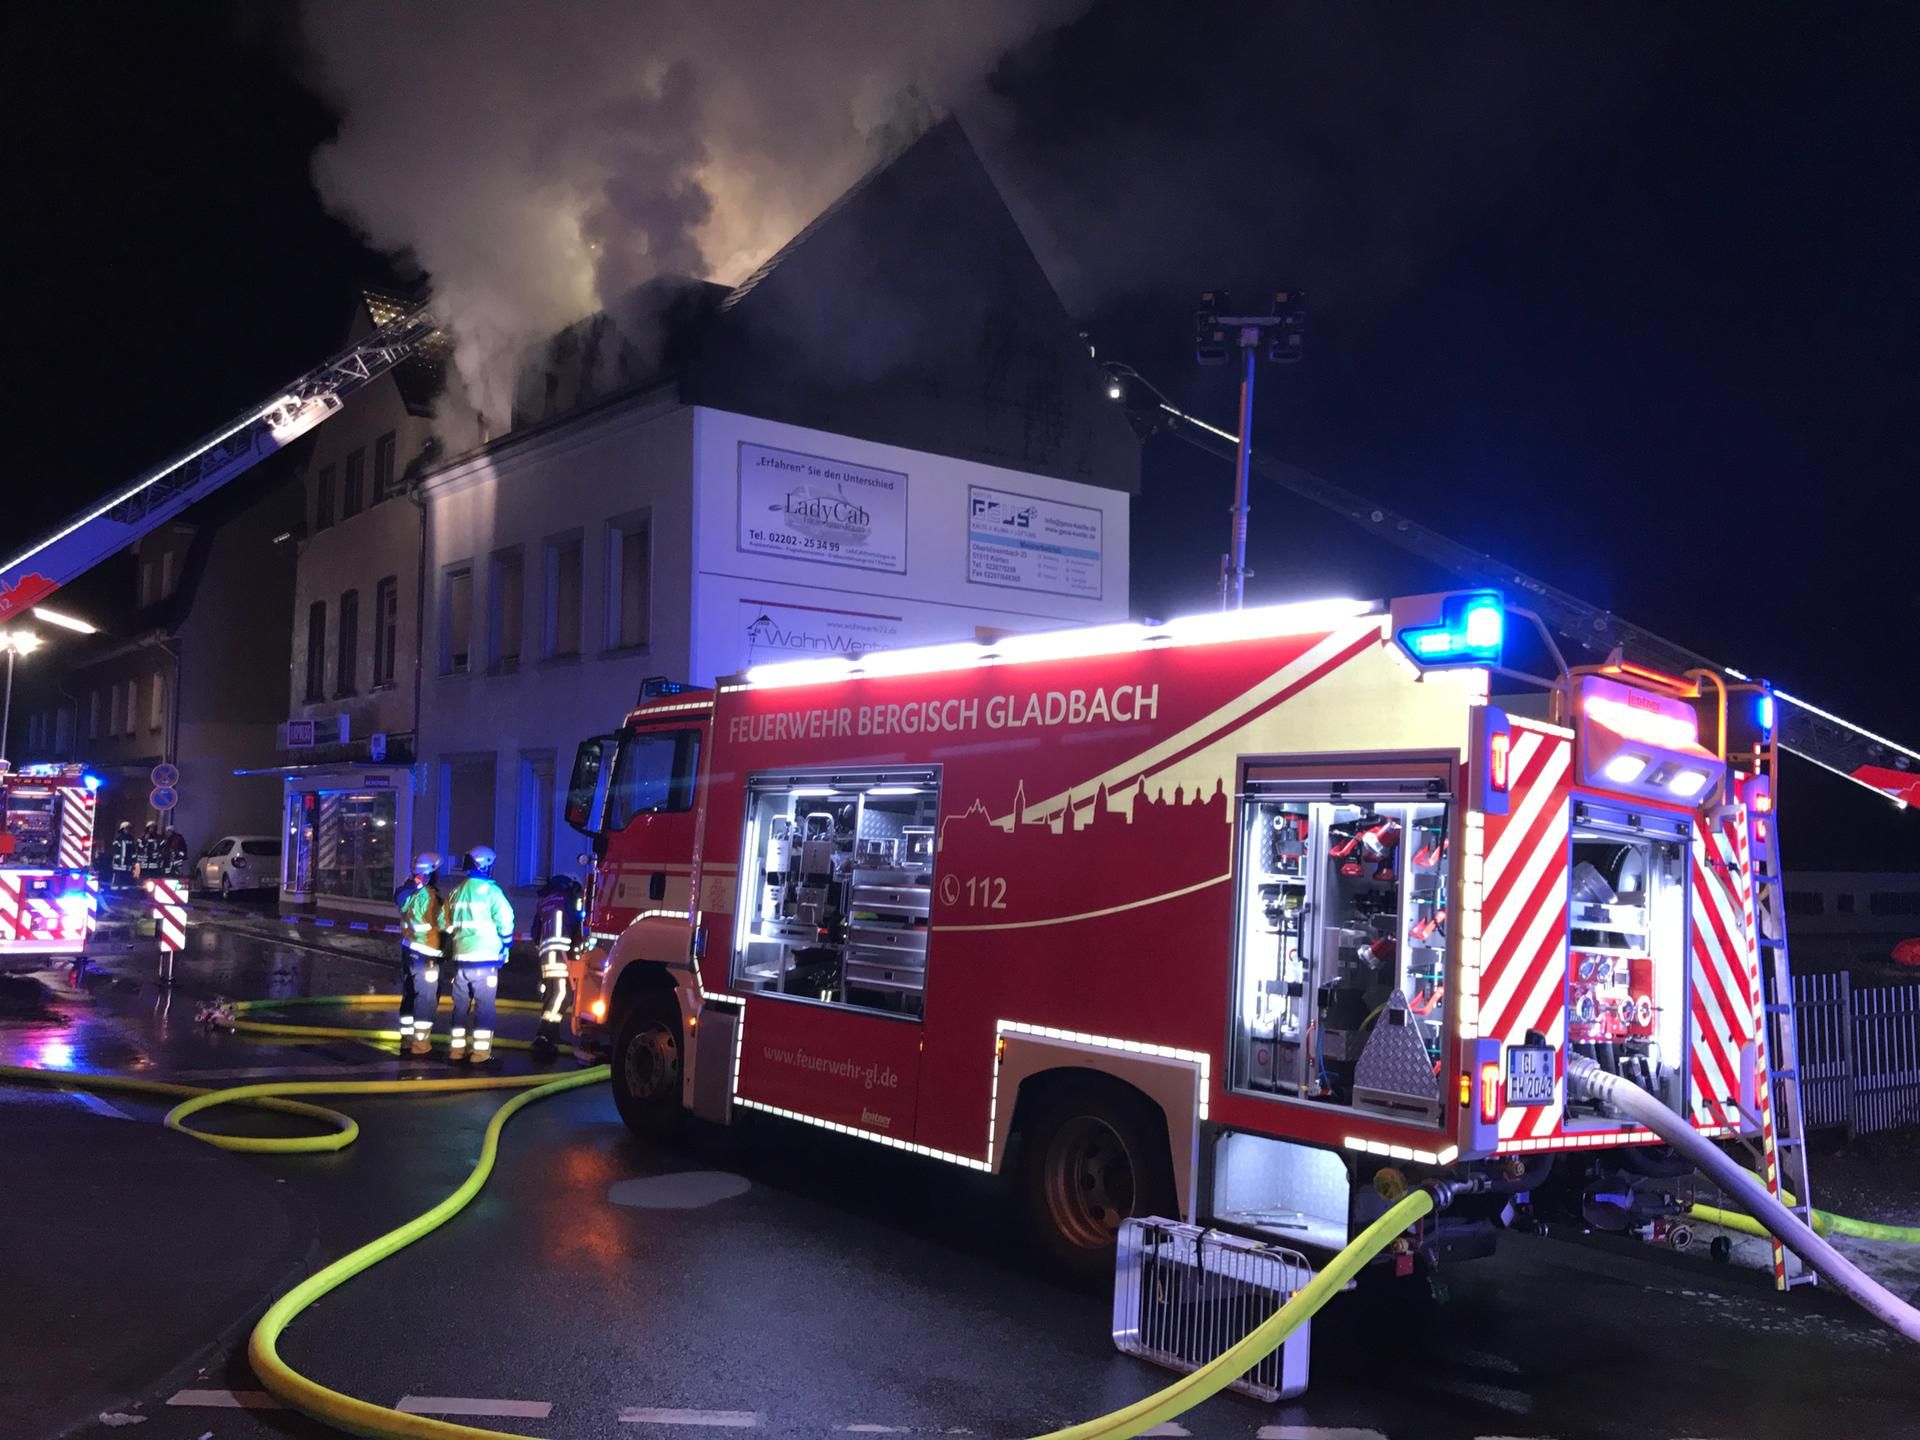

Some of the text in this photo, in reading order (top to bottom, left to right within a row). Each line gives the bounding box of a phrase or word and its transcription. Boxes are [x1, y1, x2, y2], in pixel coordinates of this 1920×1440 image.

[808, 466, 821, 477] Sie
[824, 468, 841, 480] den
[843, 473, 895, 491] Unterschied
[785, 492, 870, 527] LadyCab
[749, 529, 766, 541] Tel.
[769, 533, 797, 546] 02202
[804, 537, 815, 548] 25
[817, 540, 828, 550] 34
[829, 542, 840, 552] 99
[728, 684, 1159, 744] FEUERWEHR BERGISCH GLADBACH
[965, 876, 1008, 910] 112
[763, 1046, 898, 1089] www.feuerwehr-gl.de
[1523, 1053, 1537, 1075] GL
[1527, 1075, 1553, 1099] 2043
